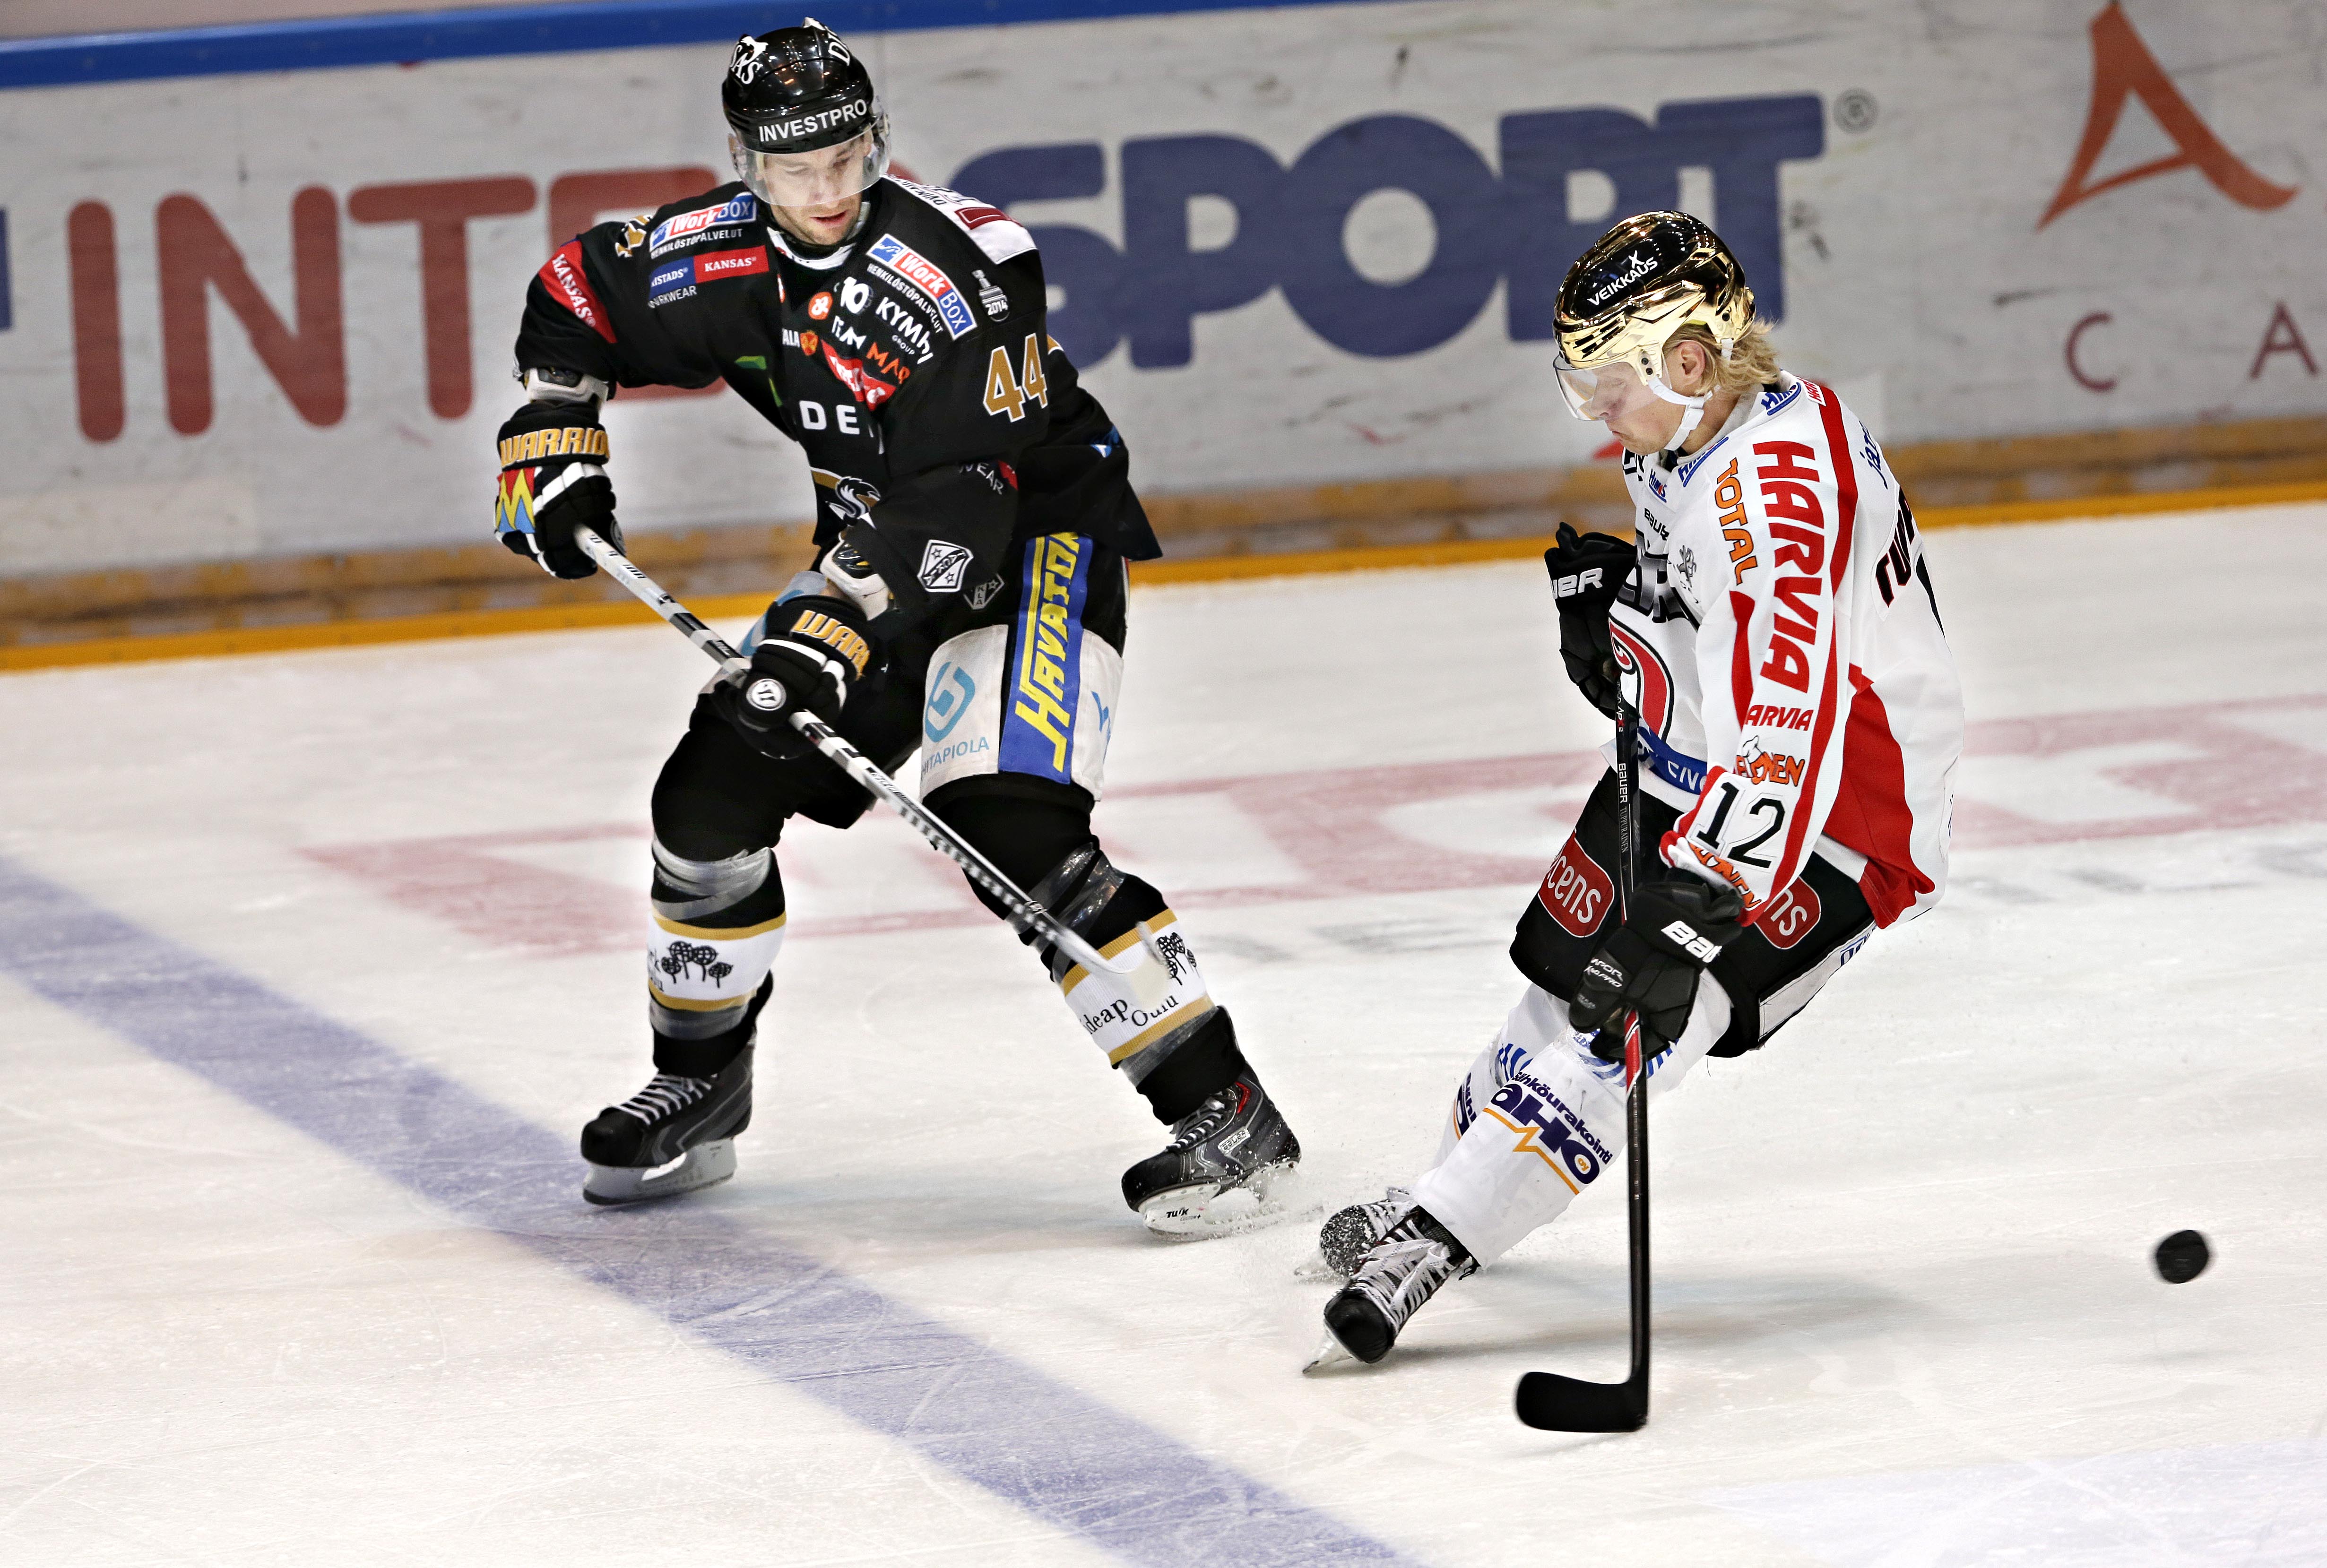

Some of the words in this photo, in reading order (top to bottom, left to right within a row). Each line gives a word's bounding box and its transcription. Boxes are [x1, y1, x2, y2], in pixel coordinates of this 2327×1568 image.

[759, 99, 868, 142] INVESTPRO
[900, 254, 945, 294] Work
[1587, 257, 1658, 306] VEIKKAUS
[985, 299, 1008, 316] 2014
[891, 334, 916, 355] GROUP
[983, 332, 1048, 422] 44
[1714, 457, 1758, 586] TOTAL
[1752, 440, 1825, 693] HARVIA
[1619, 806, 1629, 853] TUPPURAINEN
[1696, 781, 1786, 869] 12
